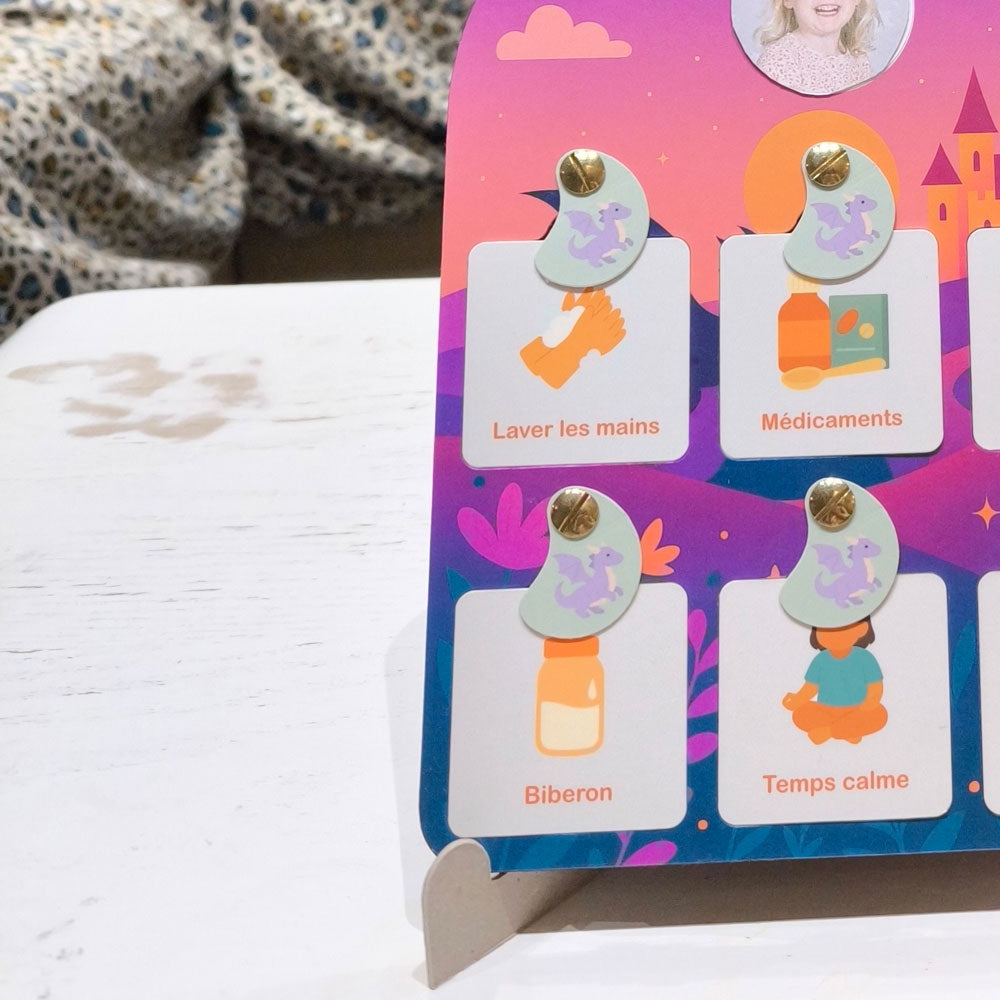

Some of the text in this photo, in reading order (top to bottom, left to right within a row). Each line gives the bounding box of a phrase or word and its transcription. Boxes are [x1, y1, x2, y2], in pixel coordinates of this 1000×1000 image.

[492, 418, 660, 440] Laver les mains
[761, 410, 903, 432] Médicaments
[762, 771, 909, 797] Temps calme
[524, 785, 613, 806] Biberon
